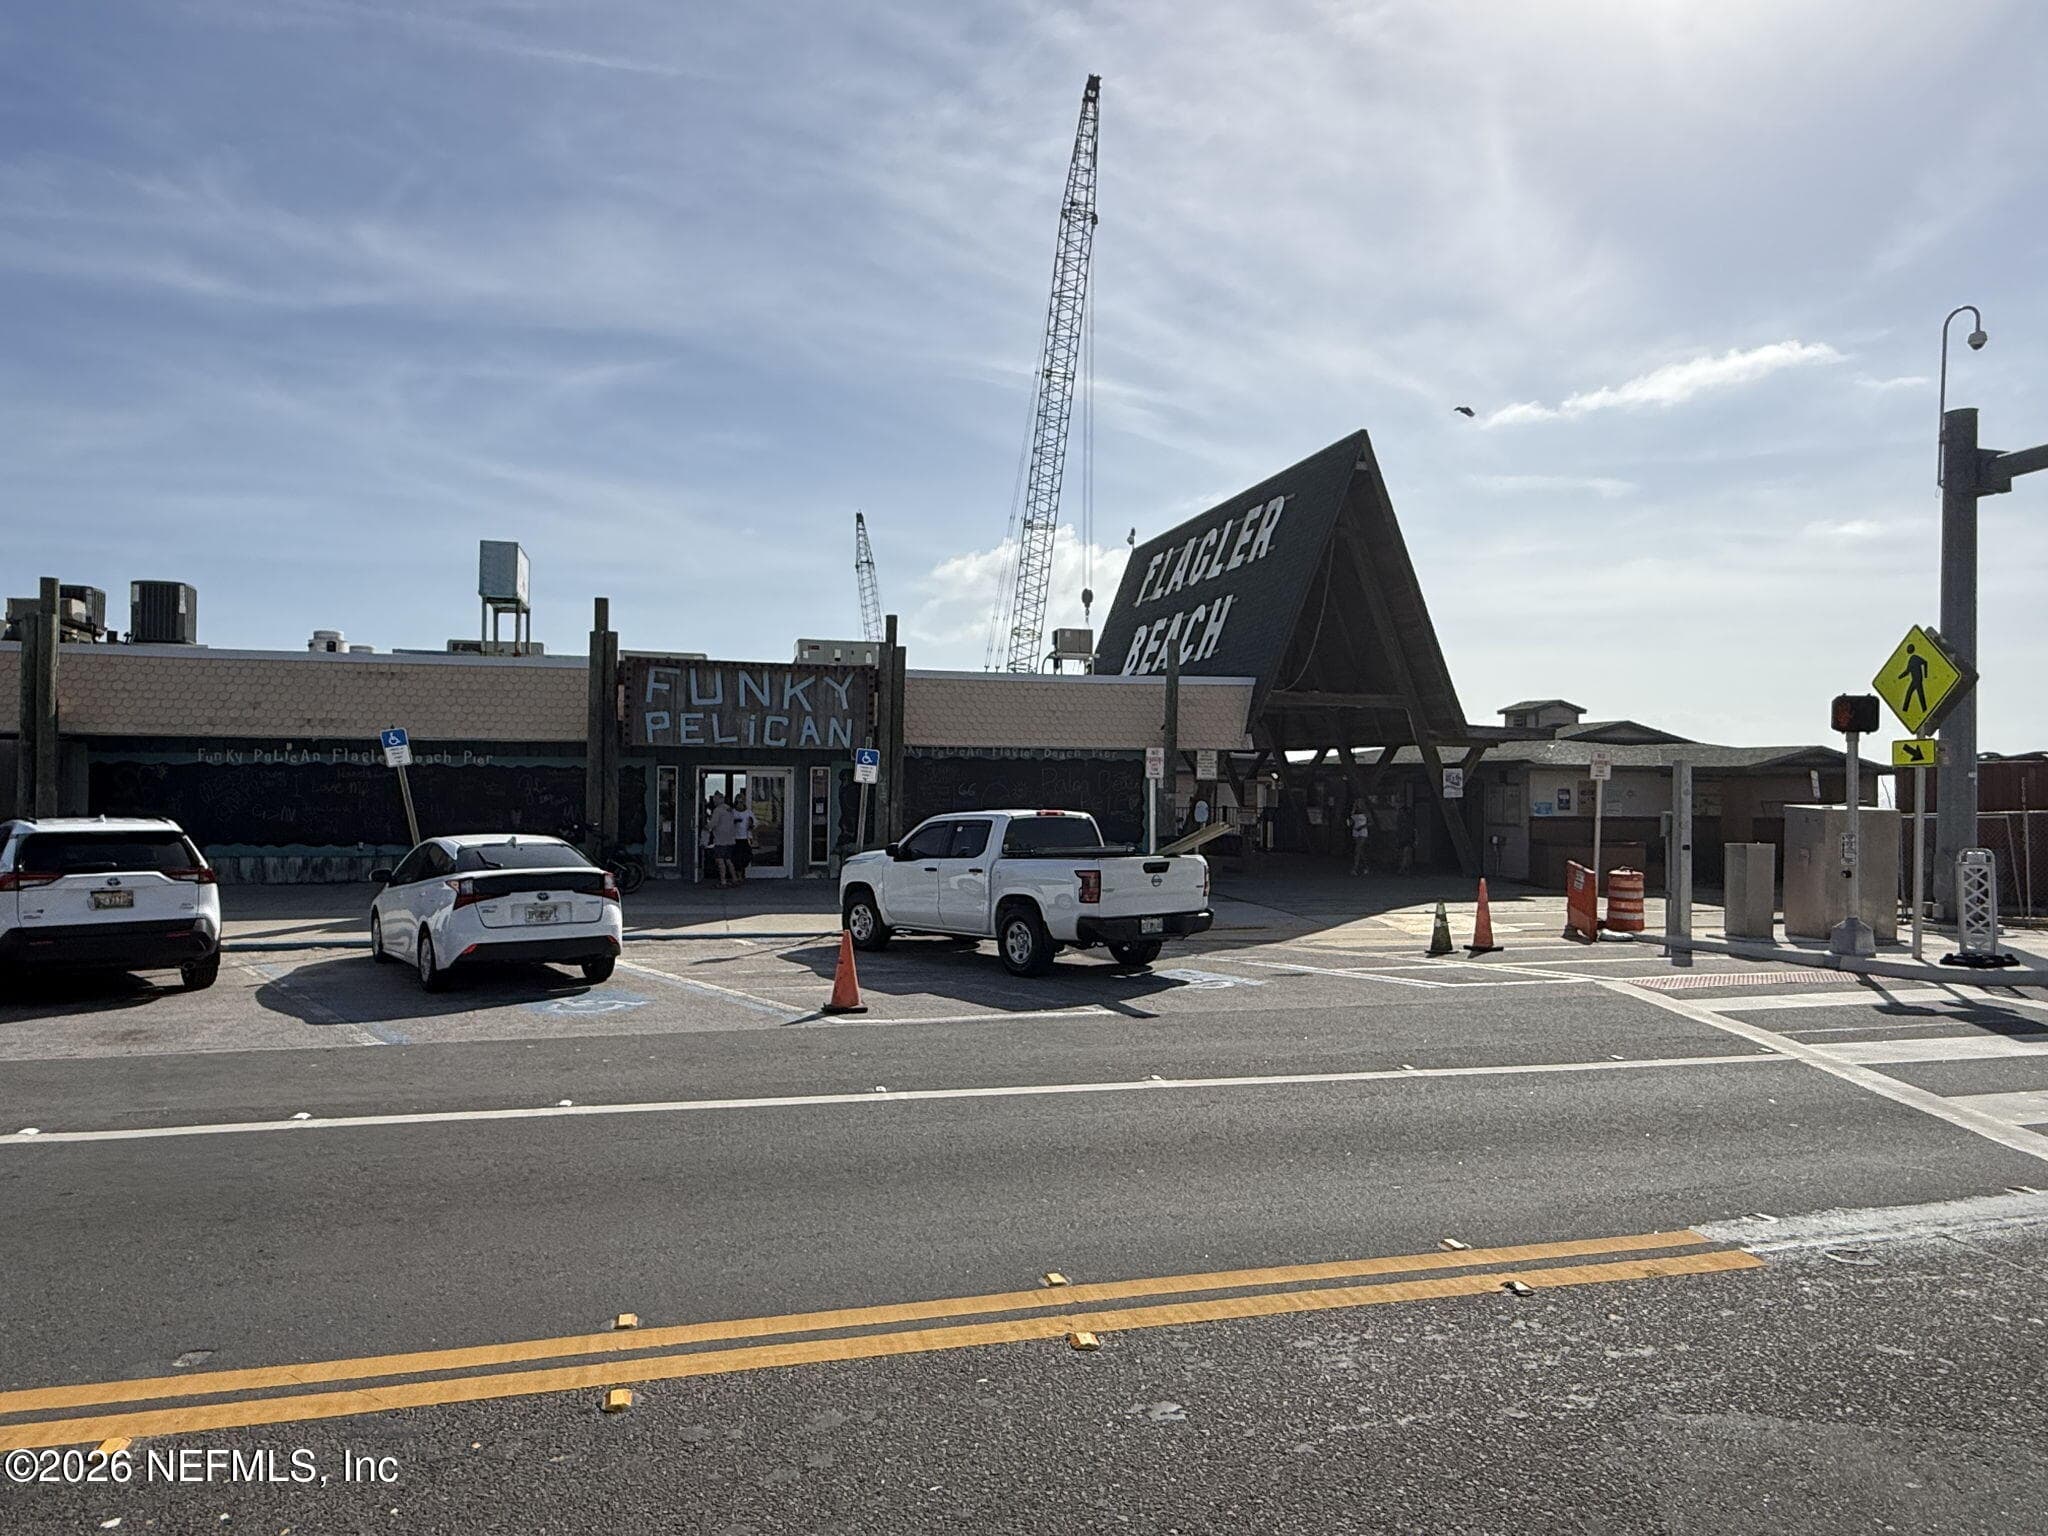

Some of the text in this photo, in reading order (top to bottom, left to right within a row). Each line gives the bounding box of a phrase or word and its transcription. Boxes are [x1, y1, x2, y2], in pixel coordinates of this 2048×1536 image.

[1134, 495, 1286, 607] FLAGLER
[1120, 594, 1233, 676] BEACH
[645, 666, 855, 712] FUNKY
[332, 748, 384, 766] Flagle
[410, 749, 452, 764] each
